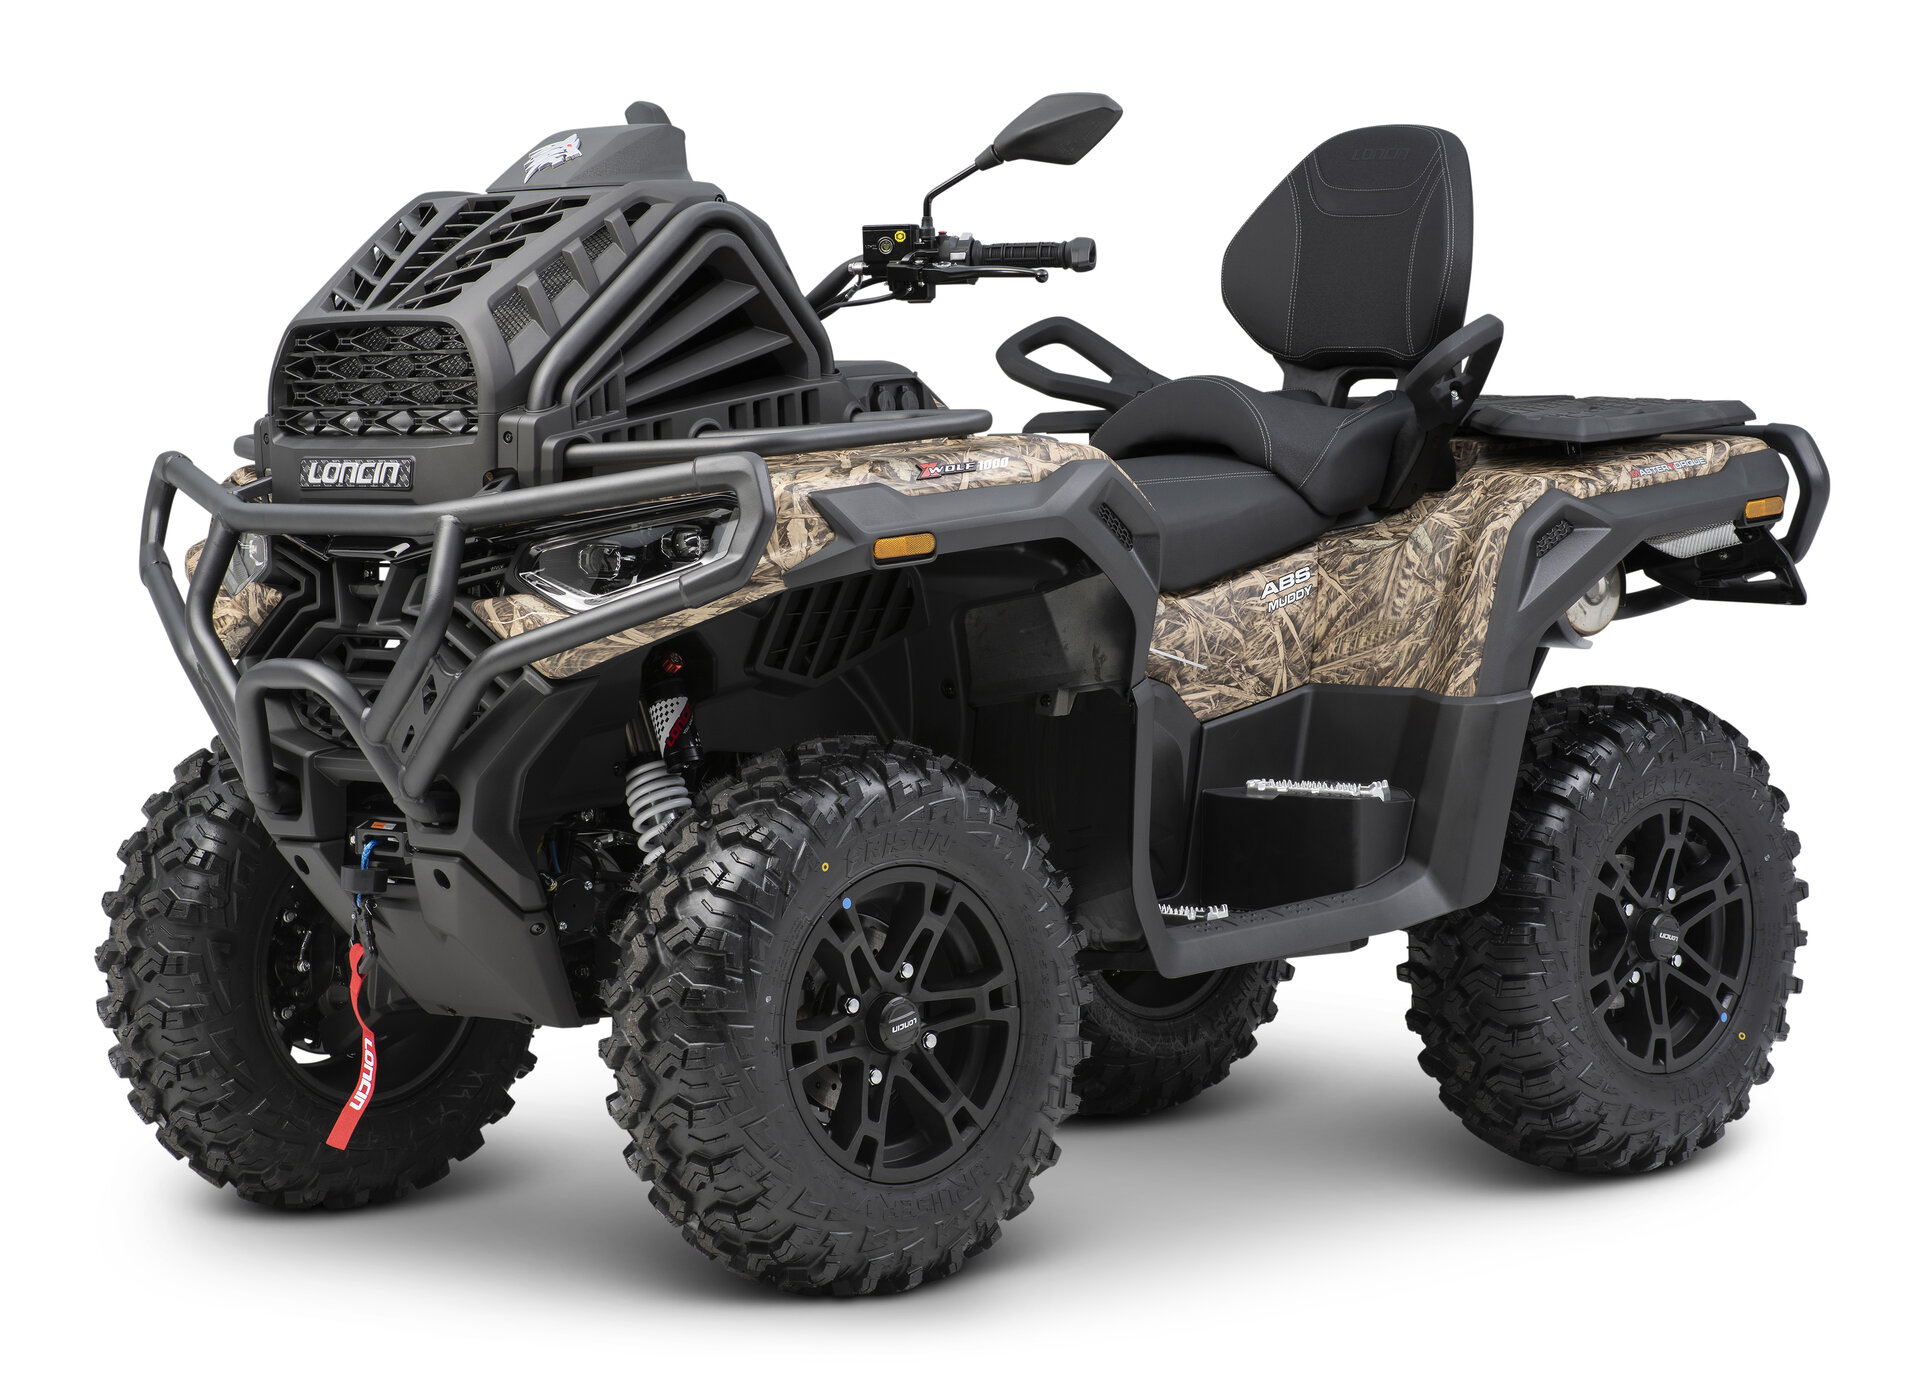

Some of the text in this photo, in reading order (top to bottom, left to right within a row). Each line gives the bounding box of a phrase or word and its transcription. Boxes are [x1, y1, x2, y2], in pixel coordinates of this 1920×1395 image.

[307, 462, 400, 484] LONCIN
[977, 457, 1009, 471] 1000
[1260, 566, 1312, 600] ABS
[1268, 584, 1313, 613] MUDDY
[891, 1017, 918, 1034] LONCIN
[349, 1037, 375, 1111] LONCIN
